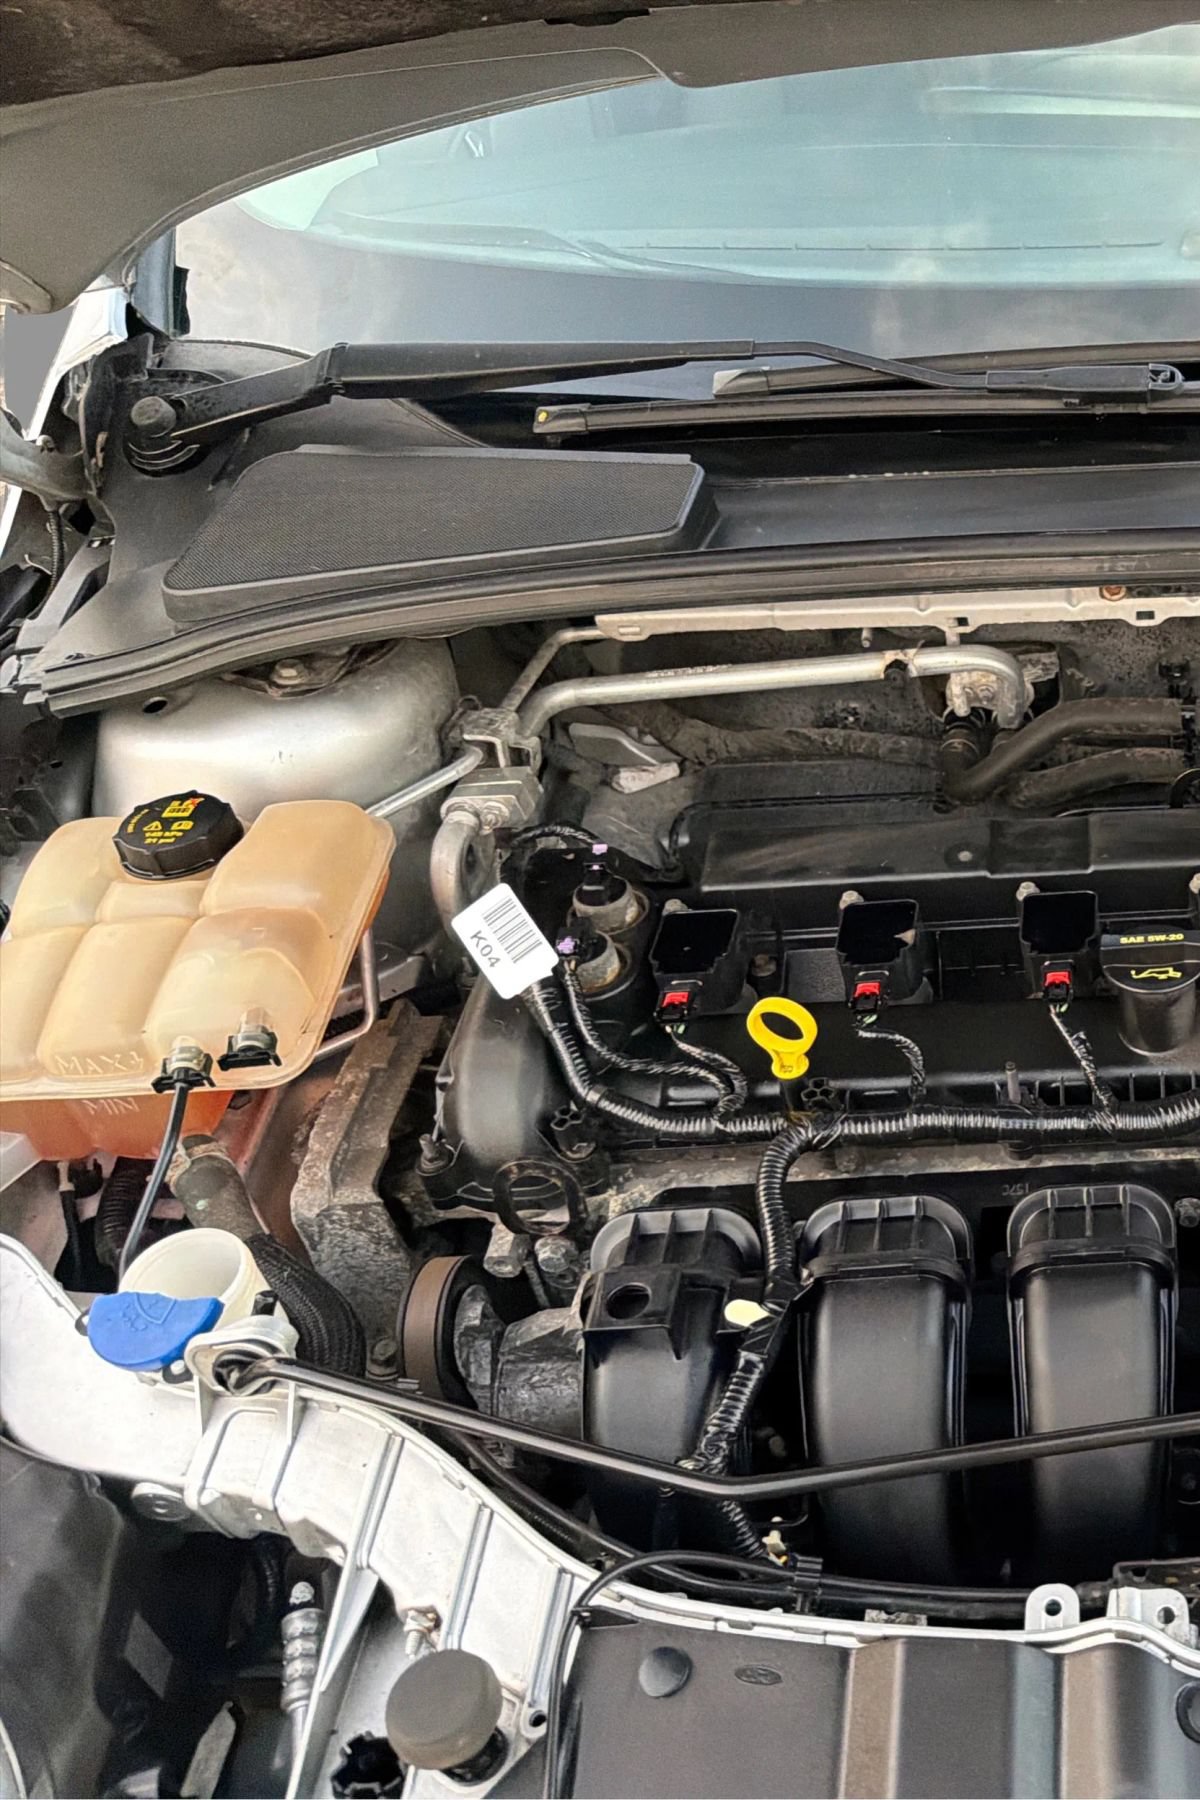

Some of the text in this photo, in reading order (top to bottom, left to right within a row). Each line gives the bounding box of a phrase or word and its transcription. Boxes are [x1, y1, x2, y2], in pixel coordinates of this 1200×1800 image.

[1120, 933, 1184, 944] SAE 5W-20
[470, 930, 501, 968] K04
[55, 1054, 127, 1076] MAX
[81, 1097, 140, 1116] MIN
